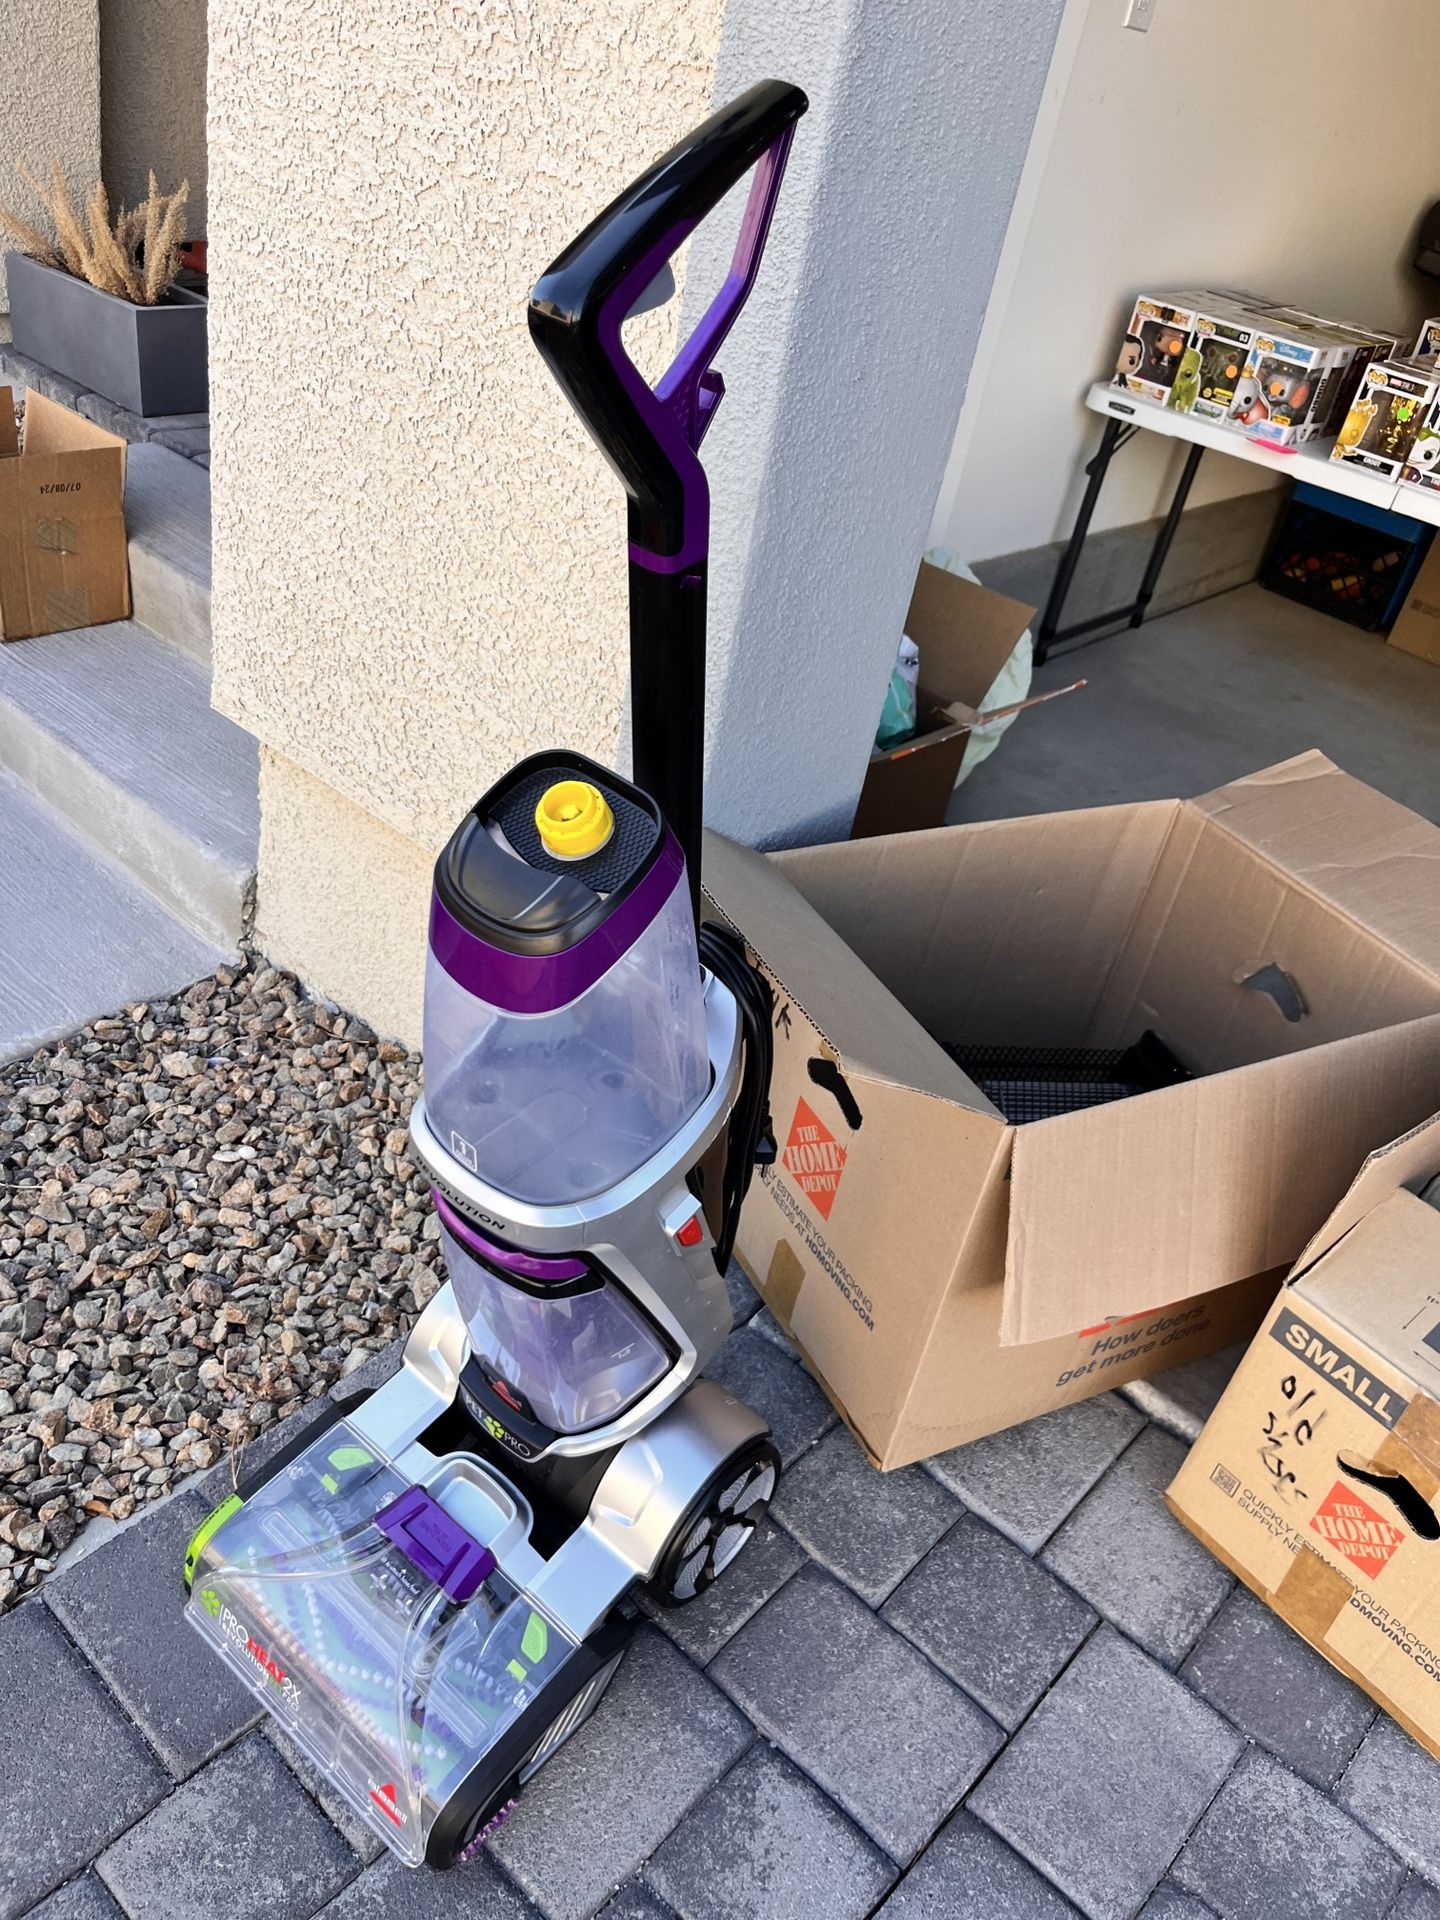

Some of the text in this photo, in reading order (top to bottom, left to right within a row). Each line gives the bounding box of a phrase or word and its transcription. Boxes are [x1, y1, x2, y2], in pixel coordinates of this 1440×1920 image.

[786, 1141, 843, 1174] HOME
[796, 1125, 820, 1143] THE
[416, 1156, 505, 1230] REVOLUTION
[801, 1174, 838, 1193] DEPOT
[771, 1187, 875, 1331] NEEDS AT HDMOVING.COM
[777, 1180, 873, 1313] ESTIMATE YOUR PACKING
[1091, 1305, 1206, 1356] How doers
[1056, 1359, 1097, 1387] get
[1100, 1340, 1157, 1368] more
[1285, 1324, 1393, 1422] SMALL
[465, 1393, 531, 1456] PET PRO
[1237, 1497, 1283, 1542] SUPPLY
[1313, 1514, 1401, 1547] HOME
[1331, 1503, 1366, 1519] THE
[1243, 1488, 1293, 1533] QUICKLY
[1355, 1584, 1389, 1620] YOUR
[1337, 1542, 1391, 1561] DEPOT
[222, 1622, 270, 1680] REVOLUTION
[282, 1692, 299, 1712] PRO
